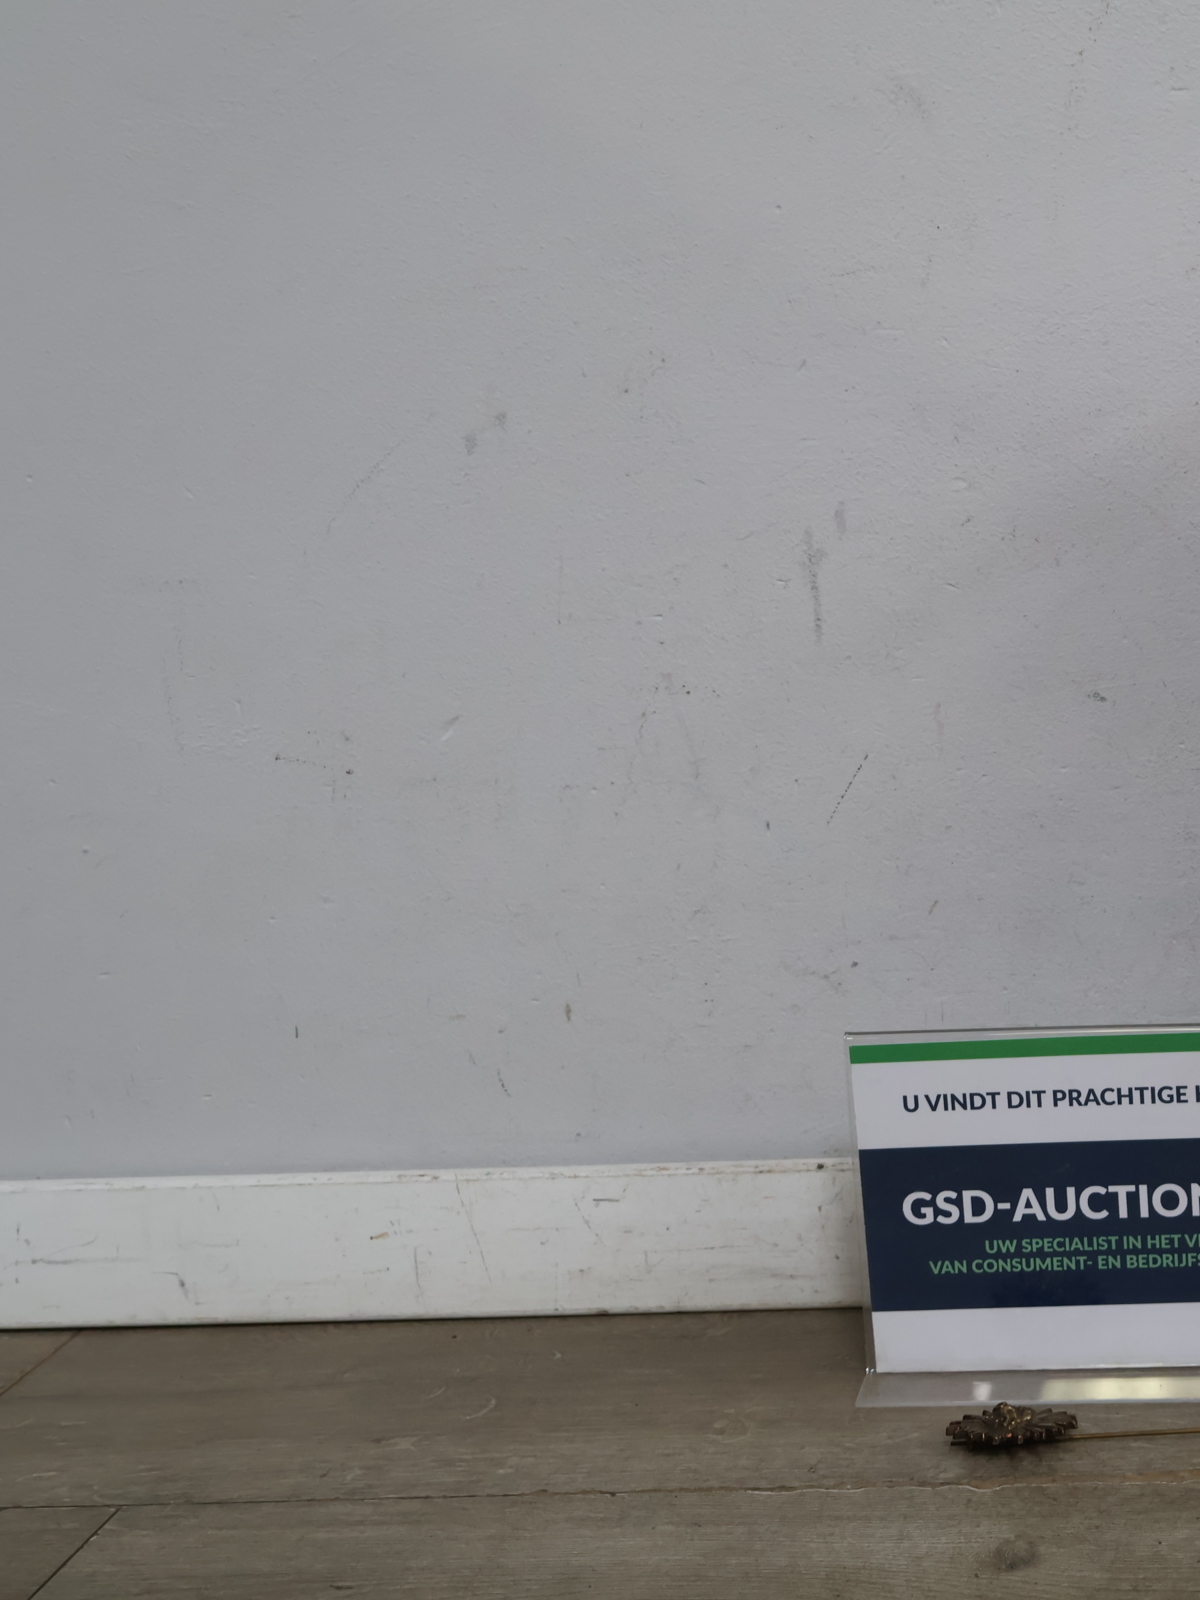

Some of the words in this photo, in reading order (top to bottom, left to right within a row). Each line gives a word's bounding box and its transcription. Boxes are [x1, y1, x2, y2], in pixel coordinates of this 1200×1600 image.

[902, 1094, 920, 1113] U
[924, 1091, 1001, 1112] VINDT
[1006, 1089, 1047, 1109] DIT
[1052, 1085, 1189, 1108] PRACHTIGE
[984, 1239, 1018, 1254] UW
[1021, 1235, 1119, 1252] SPECIALIST
[1122, 1235, 1142, 1250] IN
[1146, 1233, 1182, 1250] HET
[929, 1259, 968, 1275] VAN
[971, 1255, 1093, 1273] CONSUMENT-
[1097, 1254, 1122, 1270] EN
